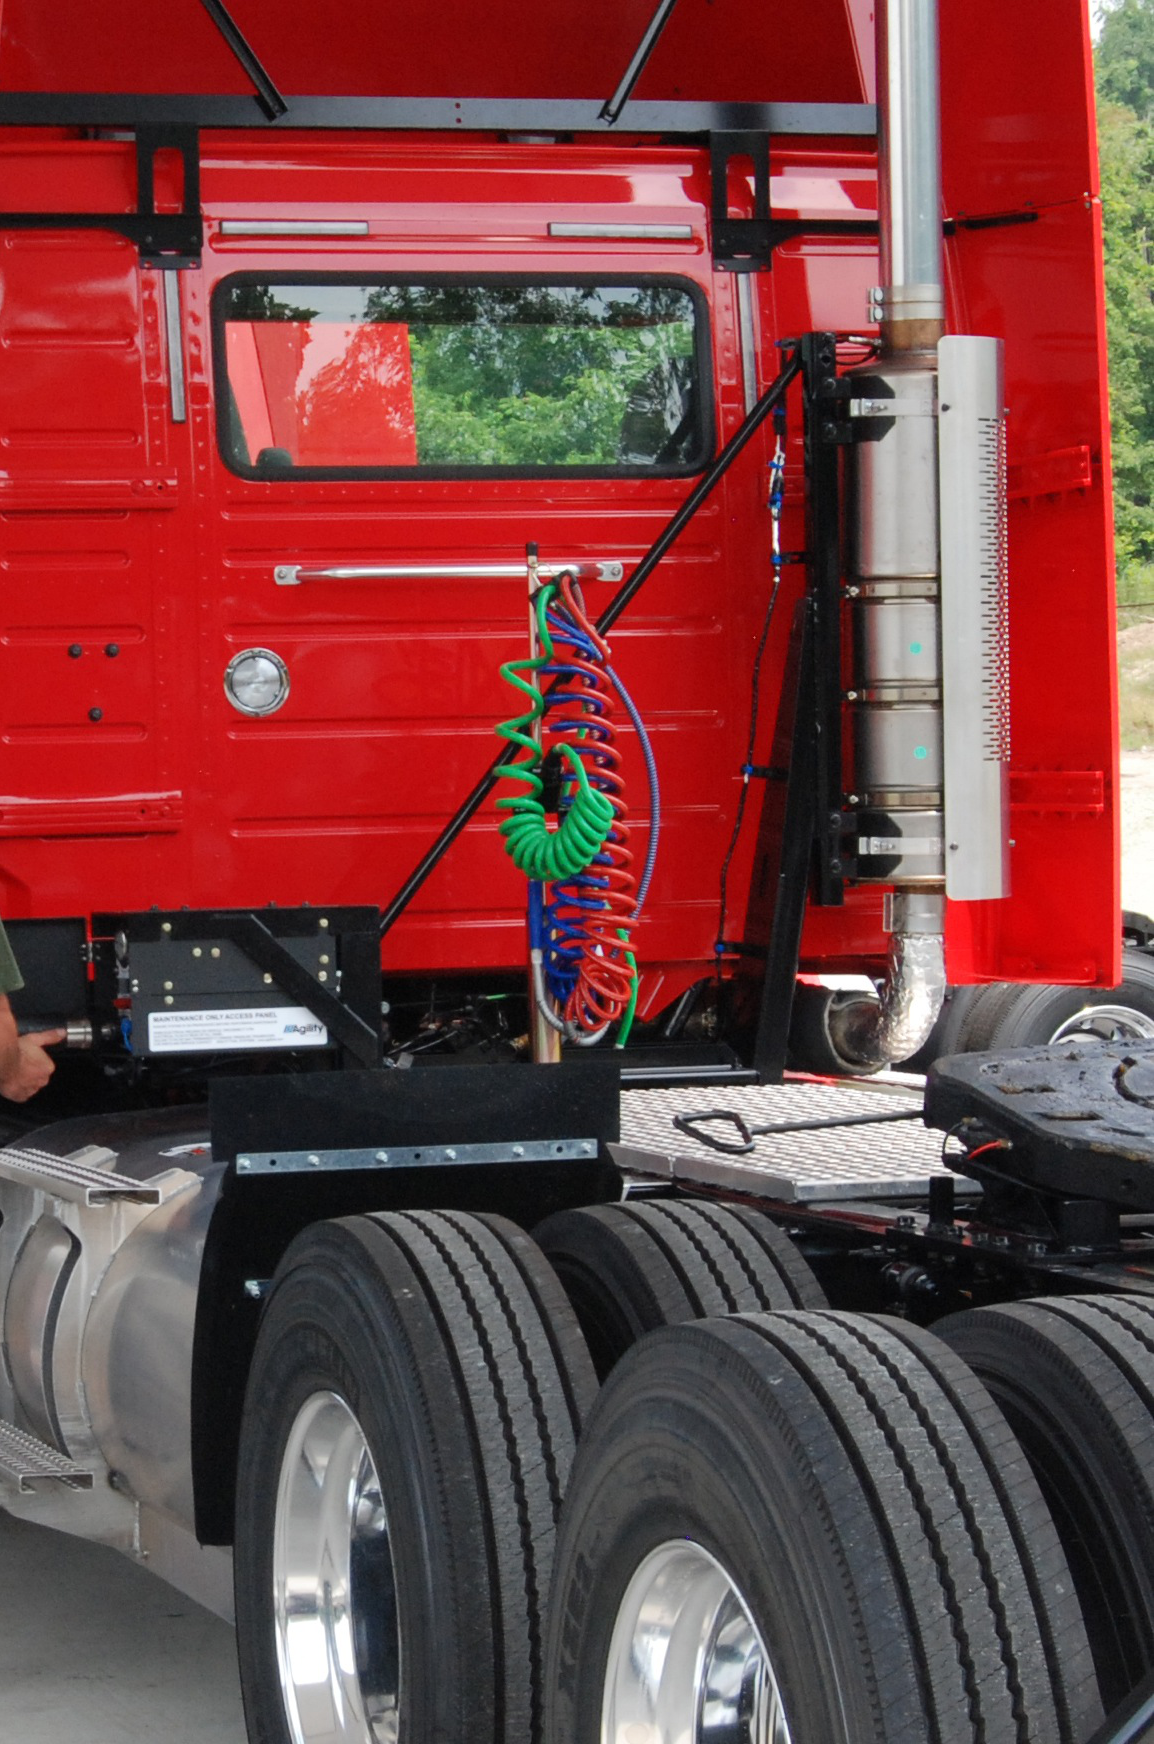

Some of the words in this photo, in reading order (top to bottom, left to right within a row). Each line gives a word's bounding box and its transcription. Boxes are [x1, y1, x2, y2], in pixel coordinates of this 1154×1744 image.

[152, 1014, 203, 1022] MAINTENANCE
[205, 1013, 224, 1021] ONLY
[225, 1012, 253, 1020] ACCESS
[255, 1011, 277, 1019] PANEL
[292, 1023, 324, 1035] Agility
